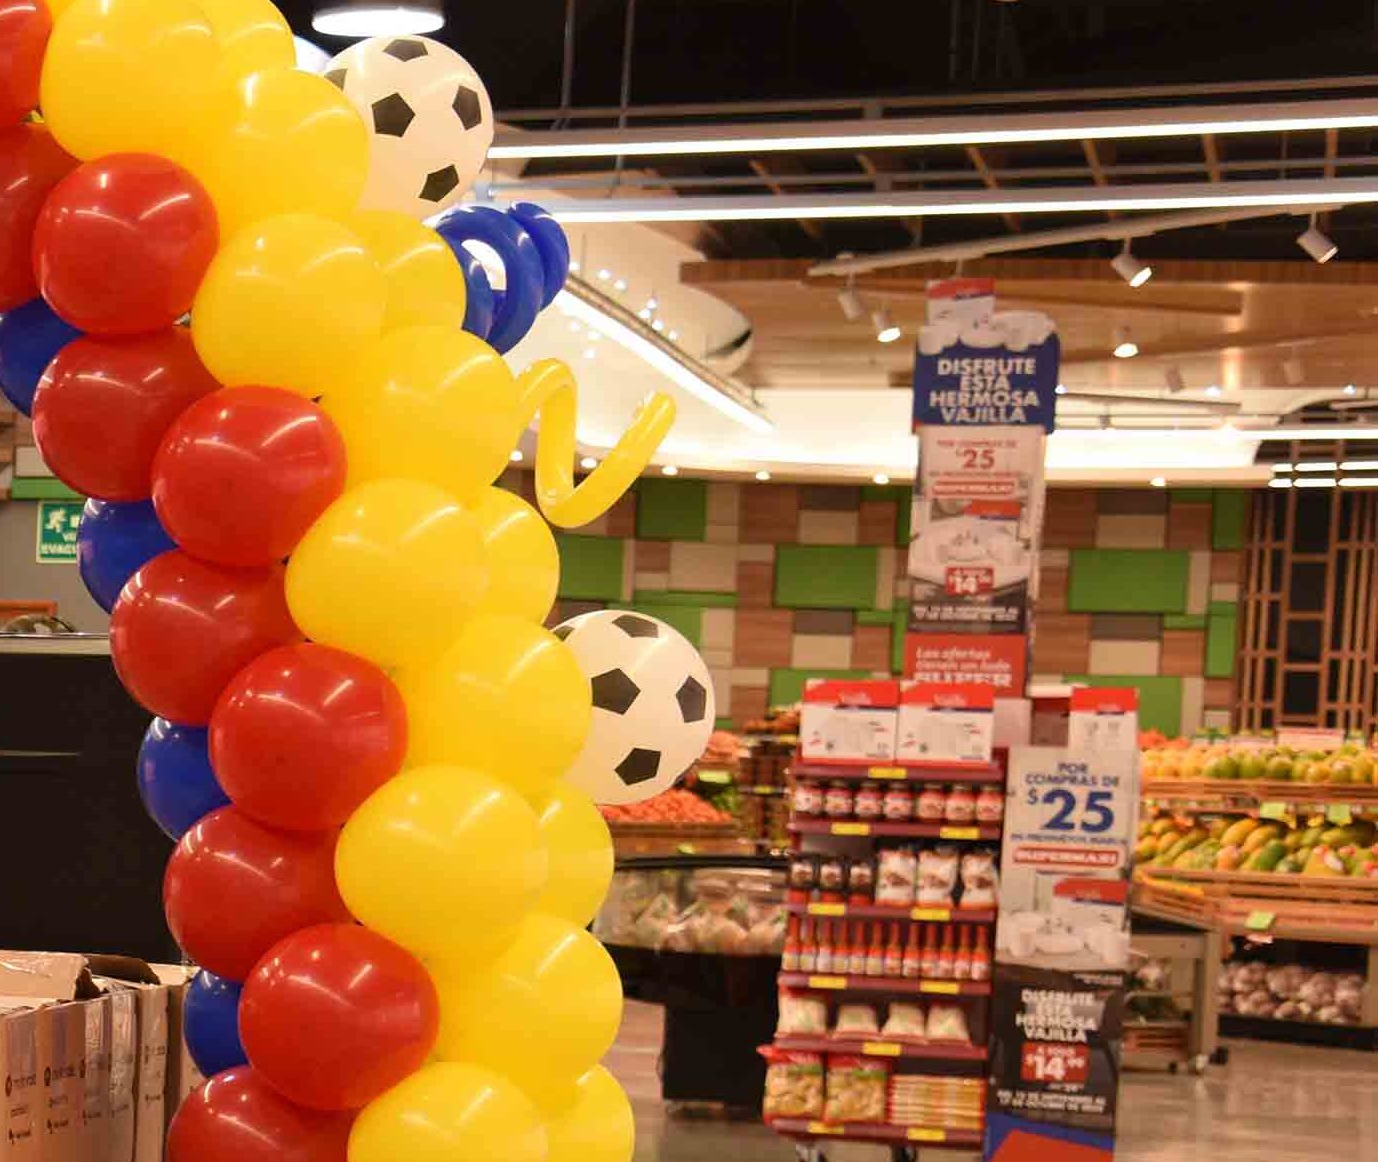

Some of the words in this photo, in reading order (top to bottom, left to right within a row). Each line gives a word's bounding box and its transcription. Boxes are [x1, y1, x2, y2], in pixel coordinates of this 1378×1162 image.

[937, 358, 1036, 374] DISFRUTE
[960, 374, 1011, 391] ESTA
[930, 390, 1039, 407] HERMOSA
[941, 406, 1027, 423] VAJILLA
[1058, 762, 1088, 774] POR
[1025, 773, 1097, 786] COMPRAS
[1028, 787, 1115, 833] $25
